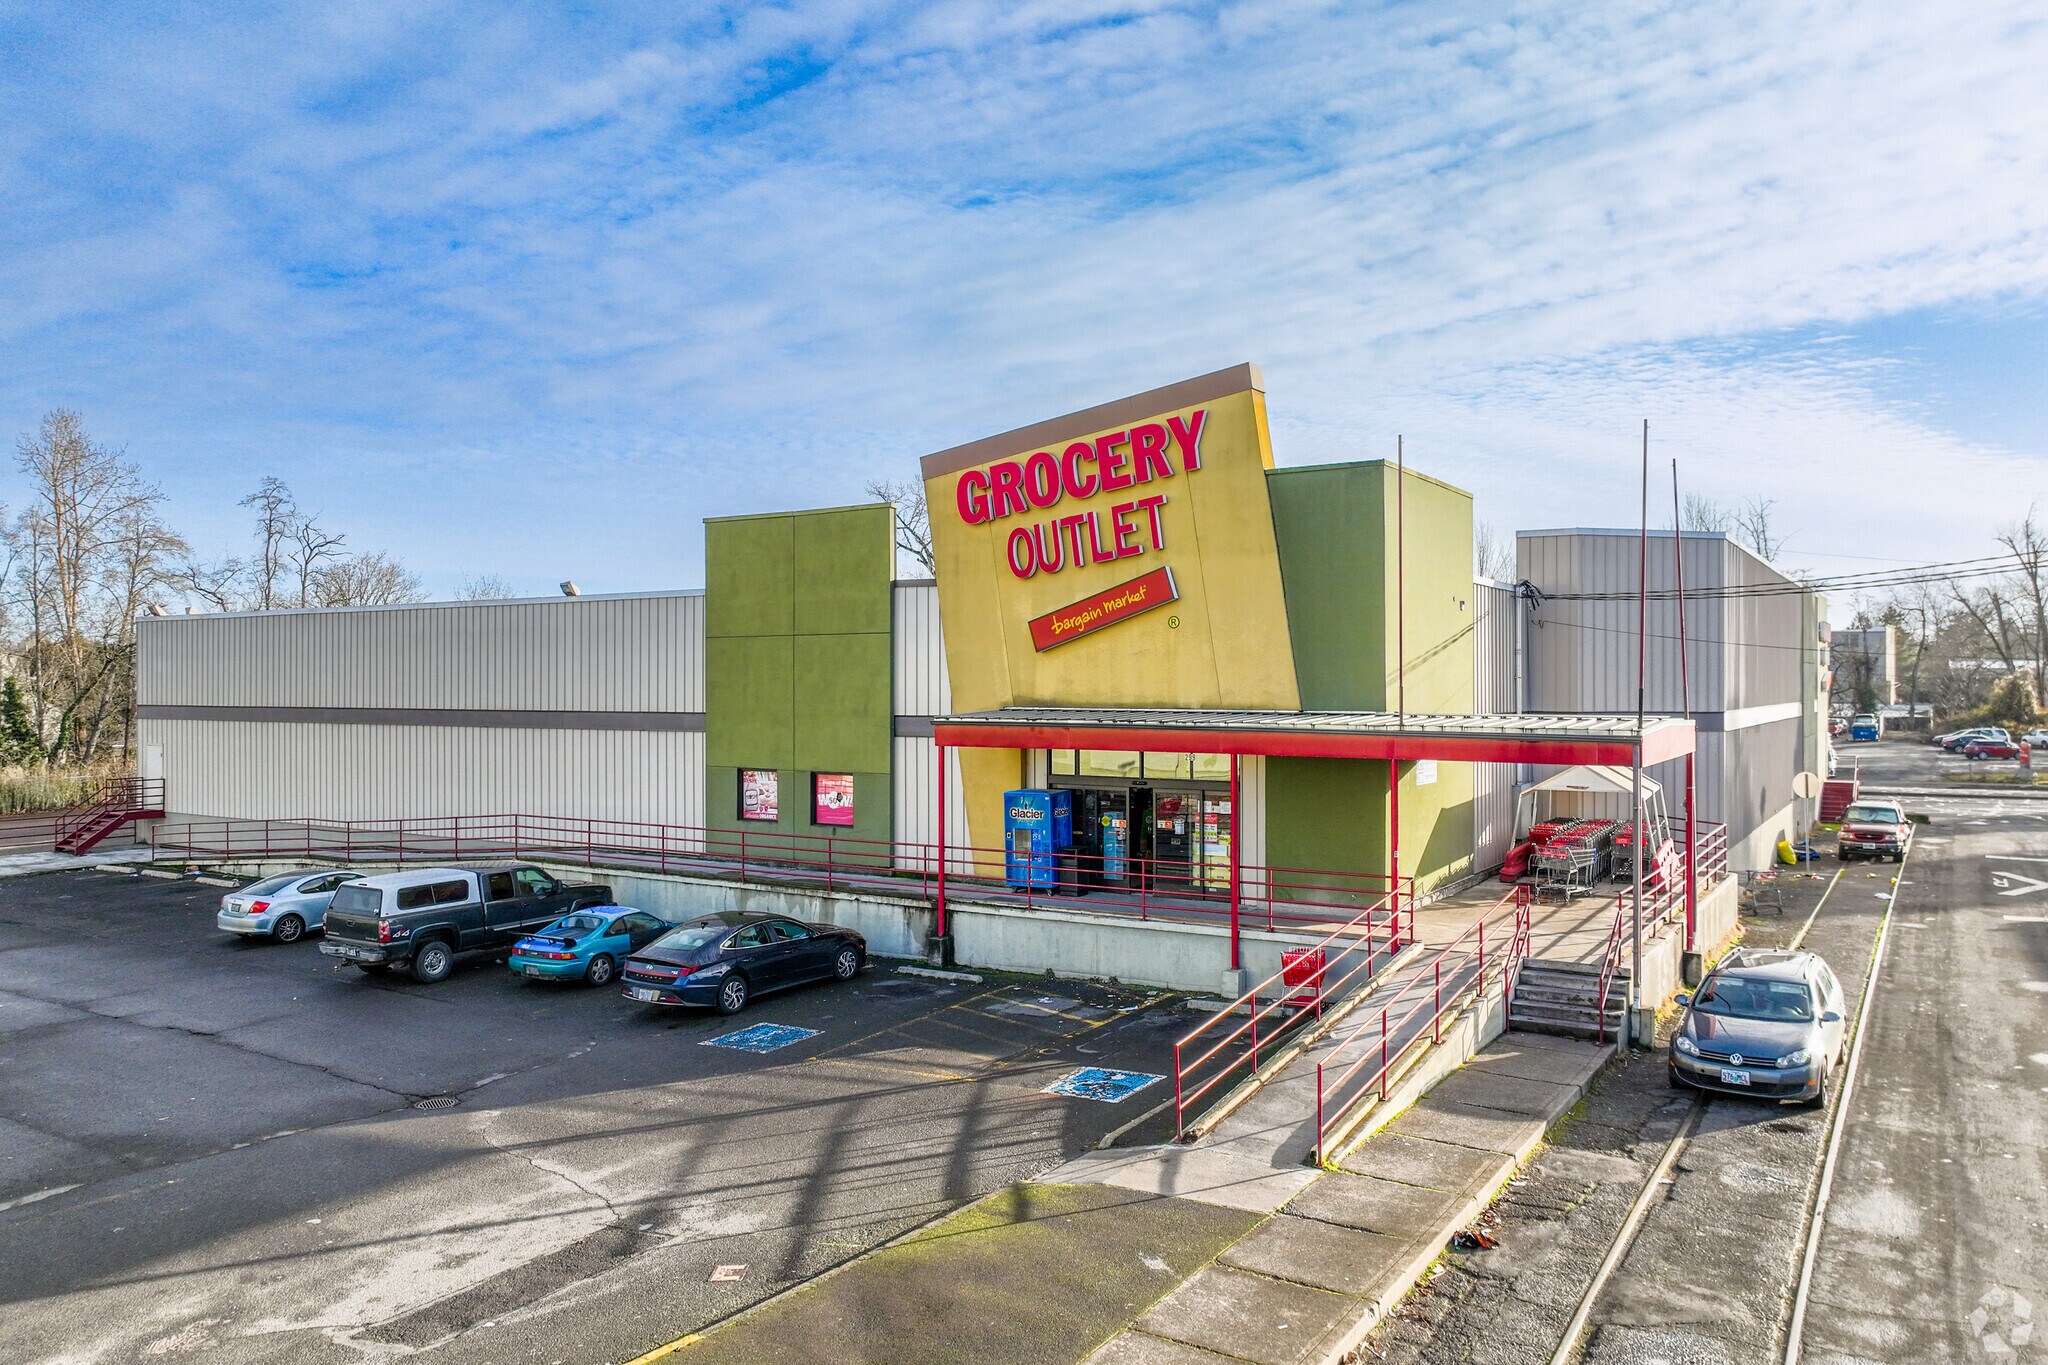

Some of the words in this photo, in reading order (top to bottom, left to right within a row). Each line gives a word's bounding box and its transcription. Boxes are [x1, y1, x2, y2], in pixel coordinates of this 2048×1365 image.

[956, 409, 1208, 525] GROCERY
[1007, 495, 1167, 579] OUTLET
[1051, 607, 1103, 635] bargain
[1103, 585, 1145, 614] market
[1010, 807, 1044, 819] Glacier
